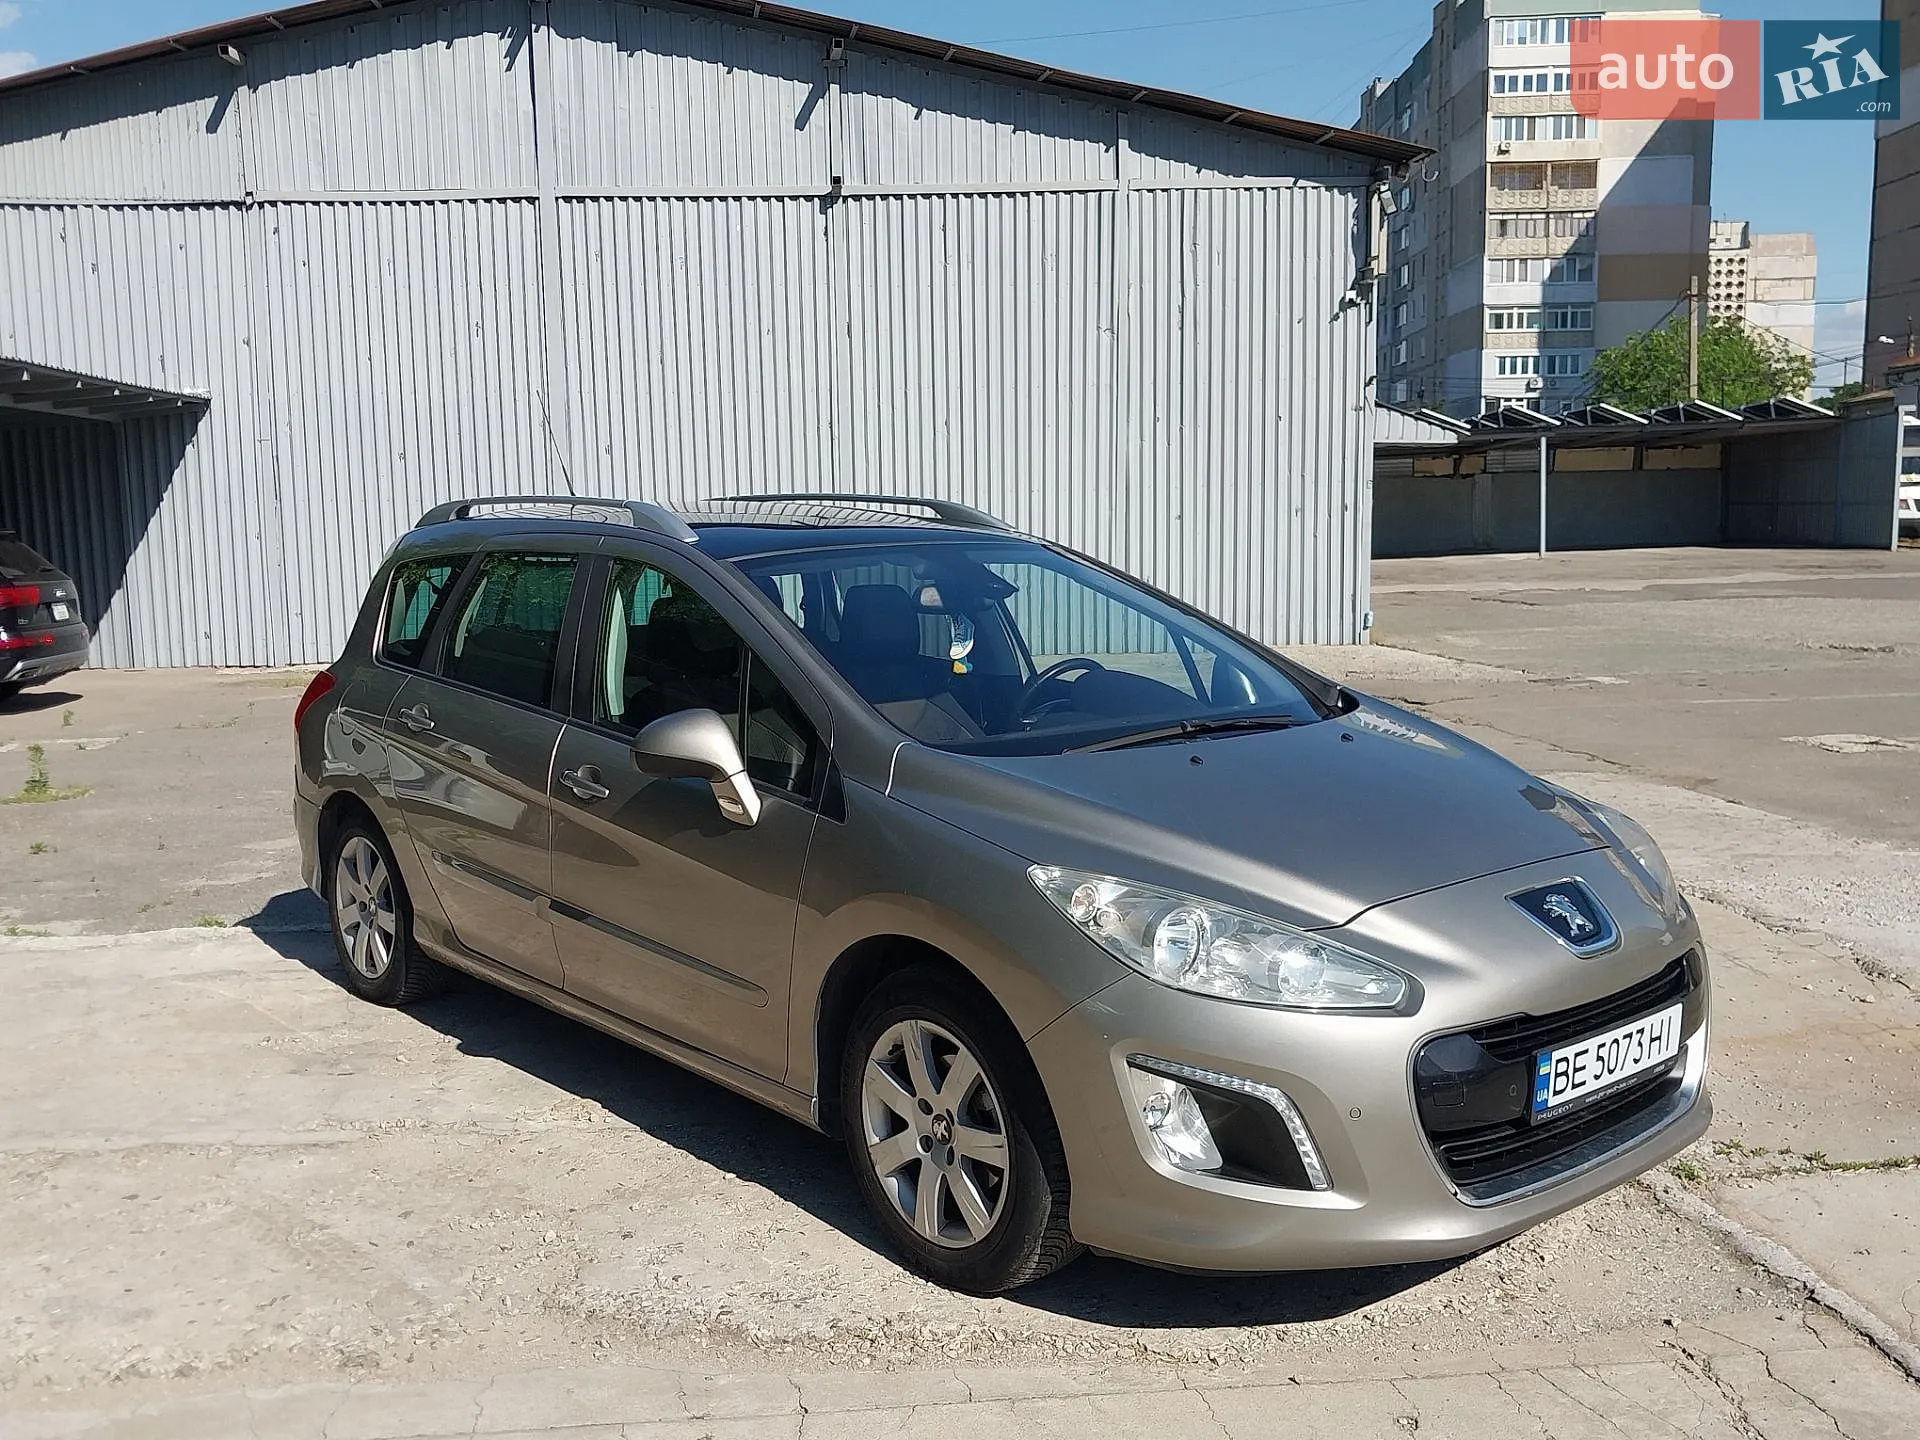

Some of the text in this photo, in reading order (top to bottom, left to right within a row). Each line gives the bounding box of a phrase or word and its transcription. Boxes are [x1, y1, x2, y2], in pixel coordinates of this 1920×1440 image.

[1552, 1048, 1589, 1097] BE
[1593, 1027, 1645, 1080] 5073
[1648, 1015, 1672, 1060] HI
[1537, 1088, 1548, 1102] UA
[1537, 1103, 1573, 1120] PEUGEOT
